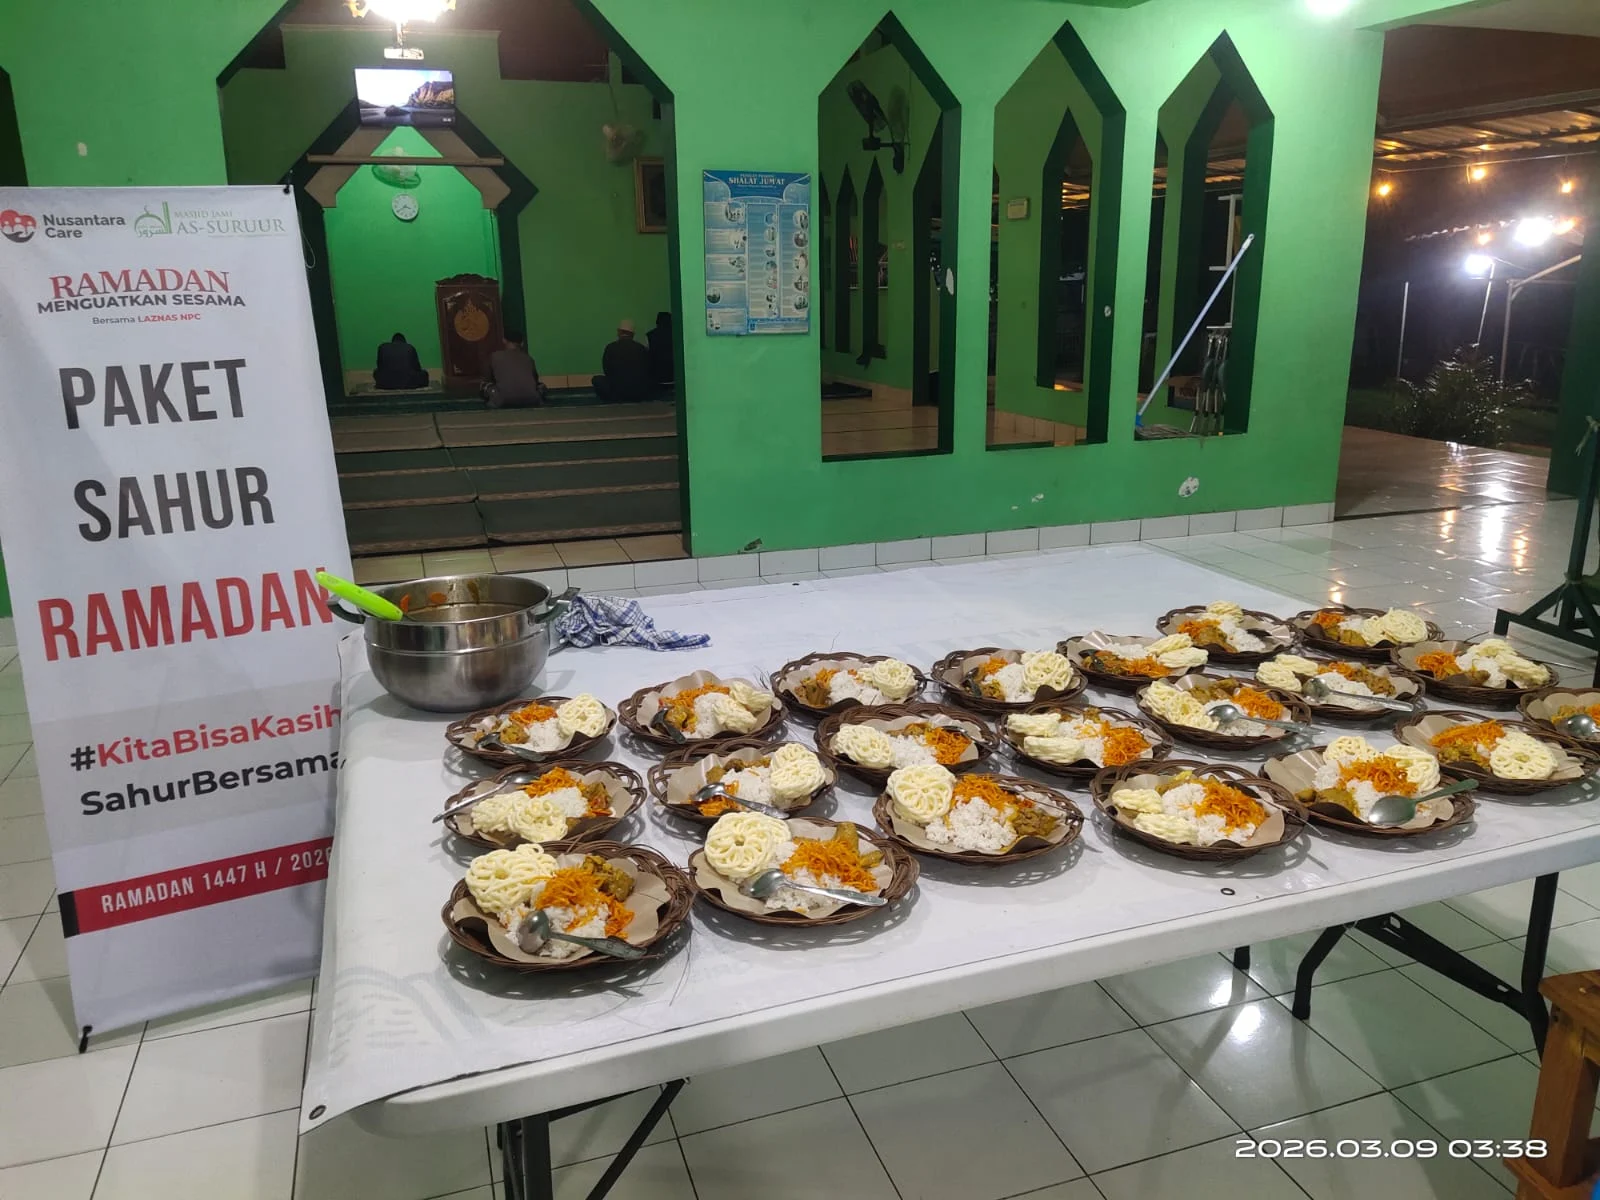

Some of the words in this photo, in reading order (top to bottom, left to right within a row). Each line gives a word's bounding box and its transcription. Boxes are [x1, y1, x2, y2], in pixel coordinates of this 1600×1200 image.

[43, 214, 126, 227] Nusantara
[45, 227, 82, 238] Care
[176, 218, 286, 235] AS-SURUUR
[49, 268, 230, 300] RAMADAN
[37, 294, 168, 314] MENGUATKAN
[172, 294, 247, 307] SESAMA
[92, 316, 136, 325] Bersama
[138, 313, 178, 323] LAZNAS
[180, 312, 201, 321] NPC
[58, 358, 247, 430] PAKET
[73, 466, 275, 543] SAHUR
[37, 566, 334, 662] RAMADAN
[100, 876, 194, 914] RAMADAN
[202, 864, 247, 891] 1447
[254, 860, 267, 879] H
[274, 856, 283, 876] /
